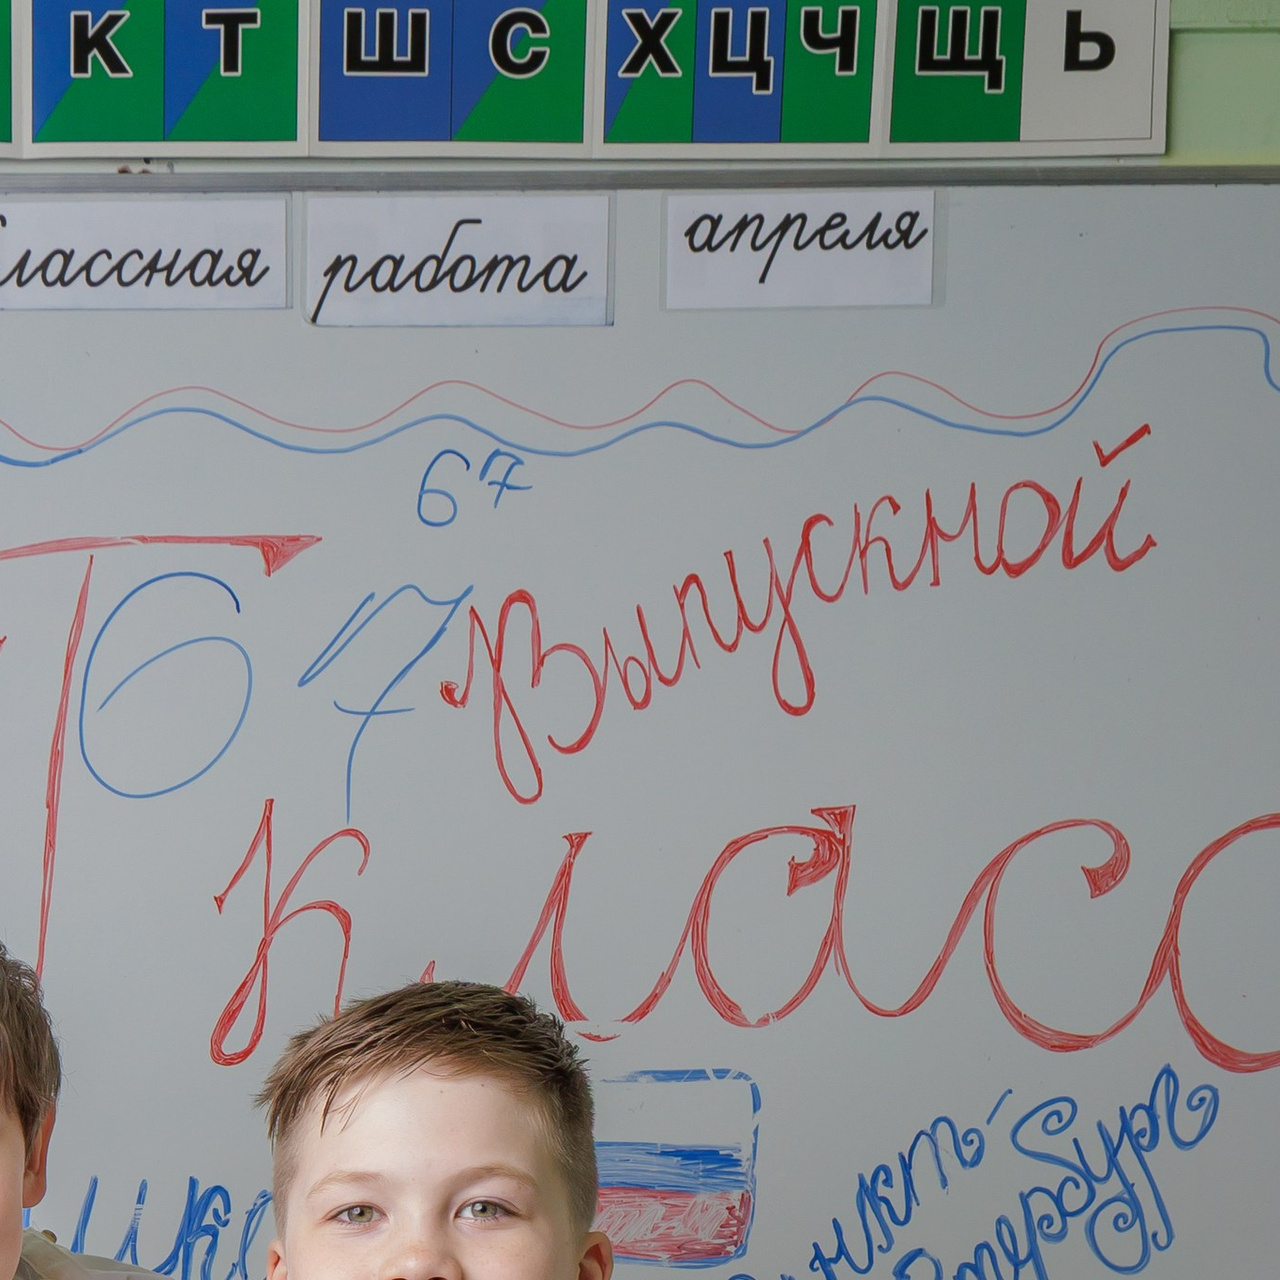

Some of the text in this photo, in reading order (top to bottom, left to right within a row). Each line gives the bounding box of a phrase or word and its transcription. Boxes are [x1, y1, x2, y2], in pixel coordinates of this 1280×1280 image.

[309, 218, 588, 325] работа
[684, 208, 929, 284] апреля
[417, 449, 533, 527] 67
[439, 423, 1158, 806] Выпускной
[80, 571, 474, 826] 67
